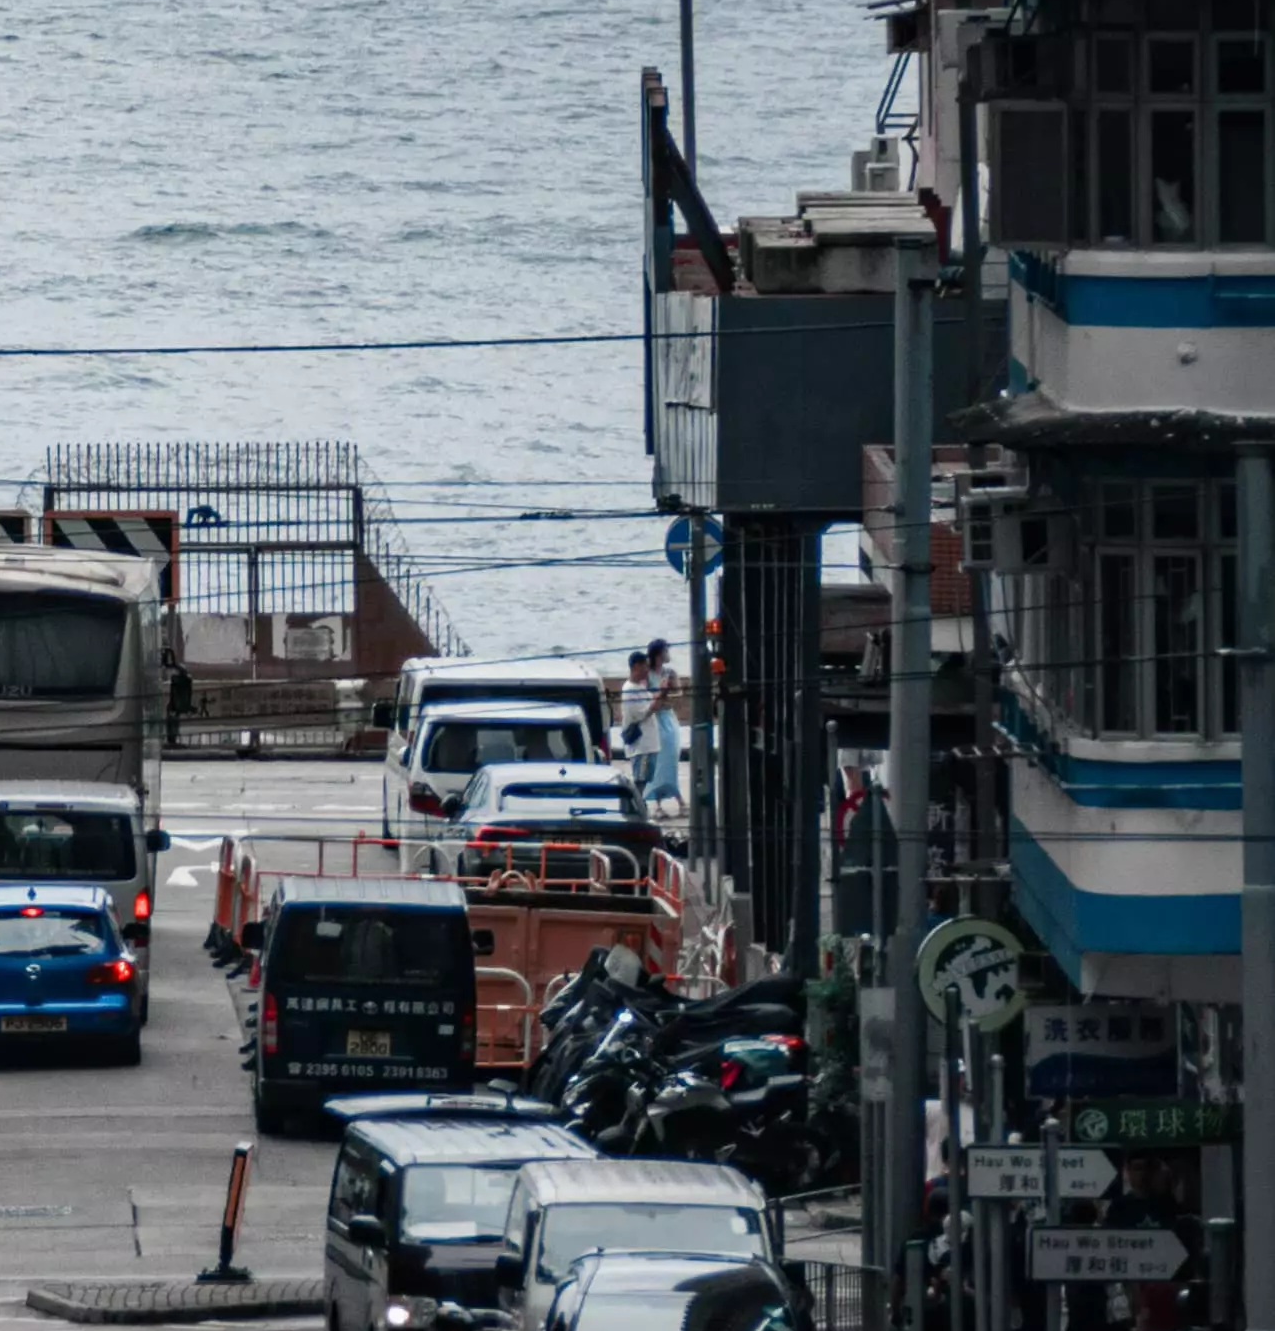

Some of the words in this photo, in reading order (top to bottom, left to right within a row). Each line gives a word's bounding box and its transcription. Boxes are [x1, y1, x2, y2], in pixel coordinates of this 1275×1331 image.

[974, 1155, 1004, 1168] Hau
[1010, 1155, 1032, 1168] Wo
[1039, 1155, 1085, 1169] Seet
[1039, 1235, 1069, 1249] Hau
[1077, 1235, 1100, 1249] Wo
[1107, 1235, 1154, 1249] Street
